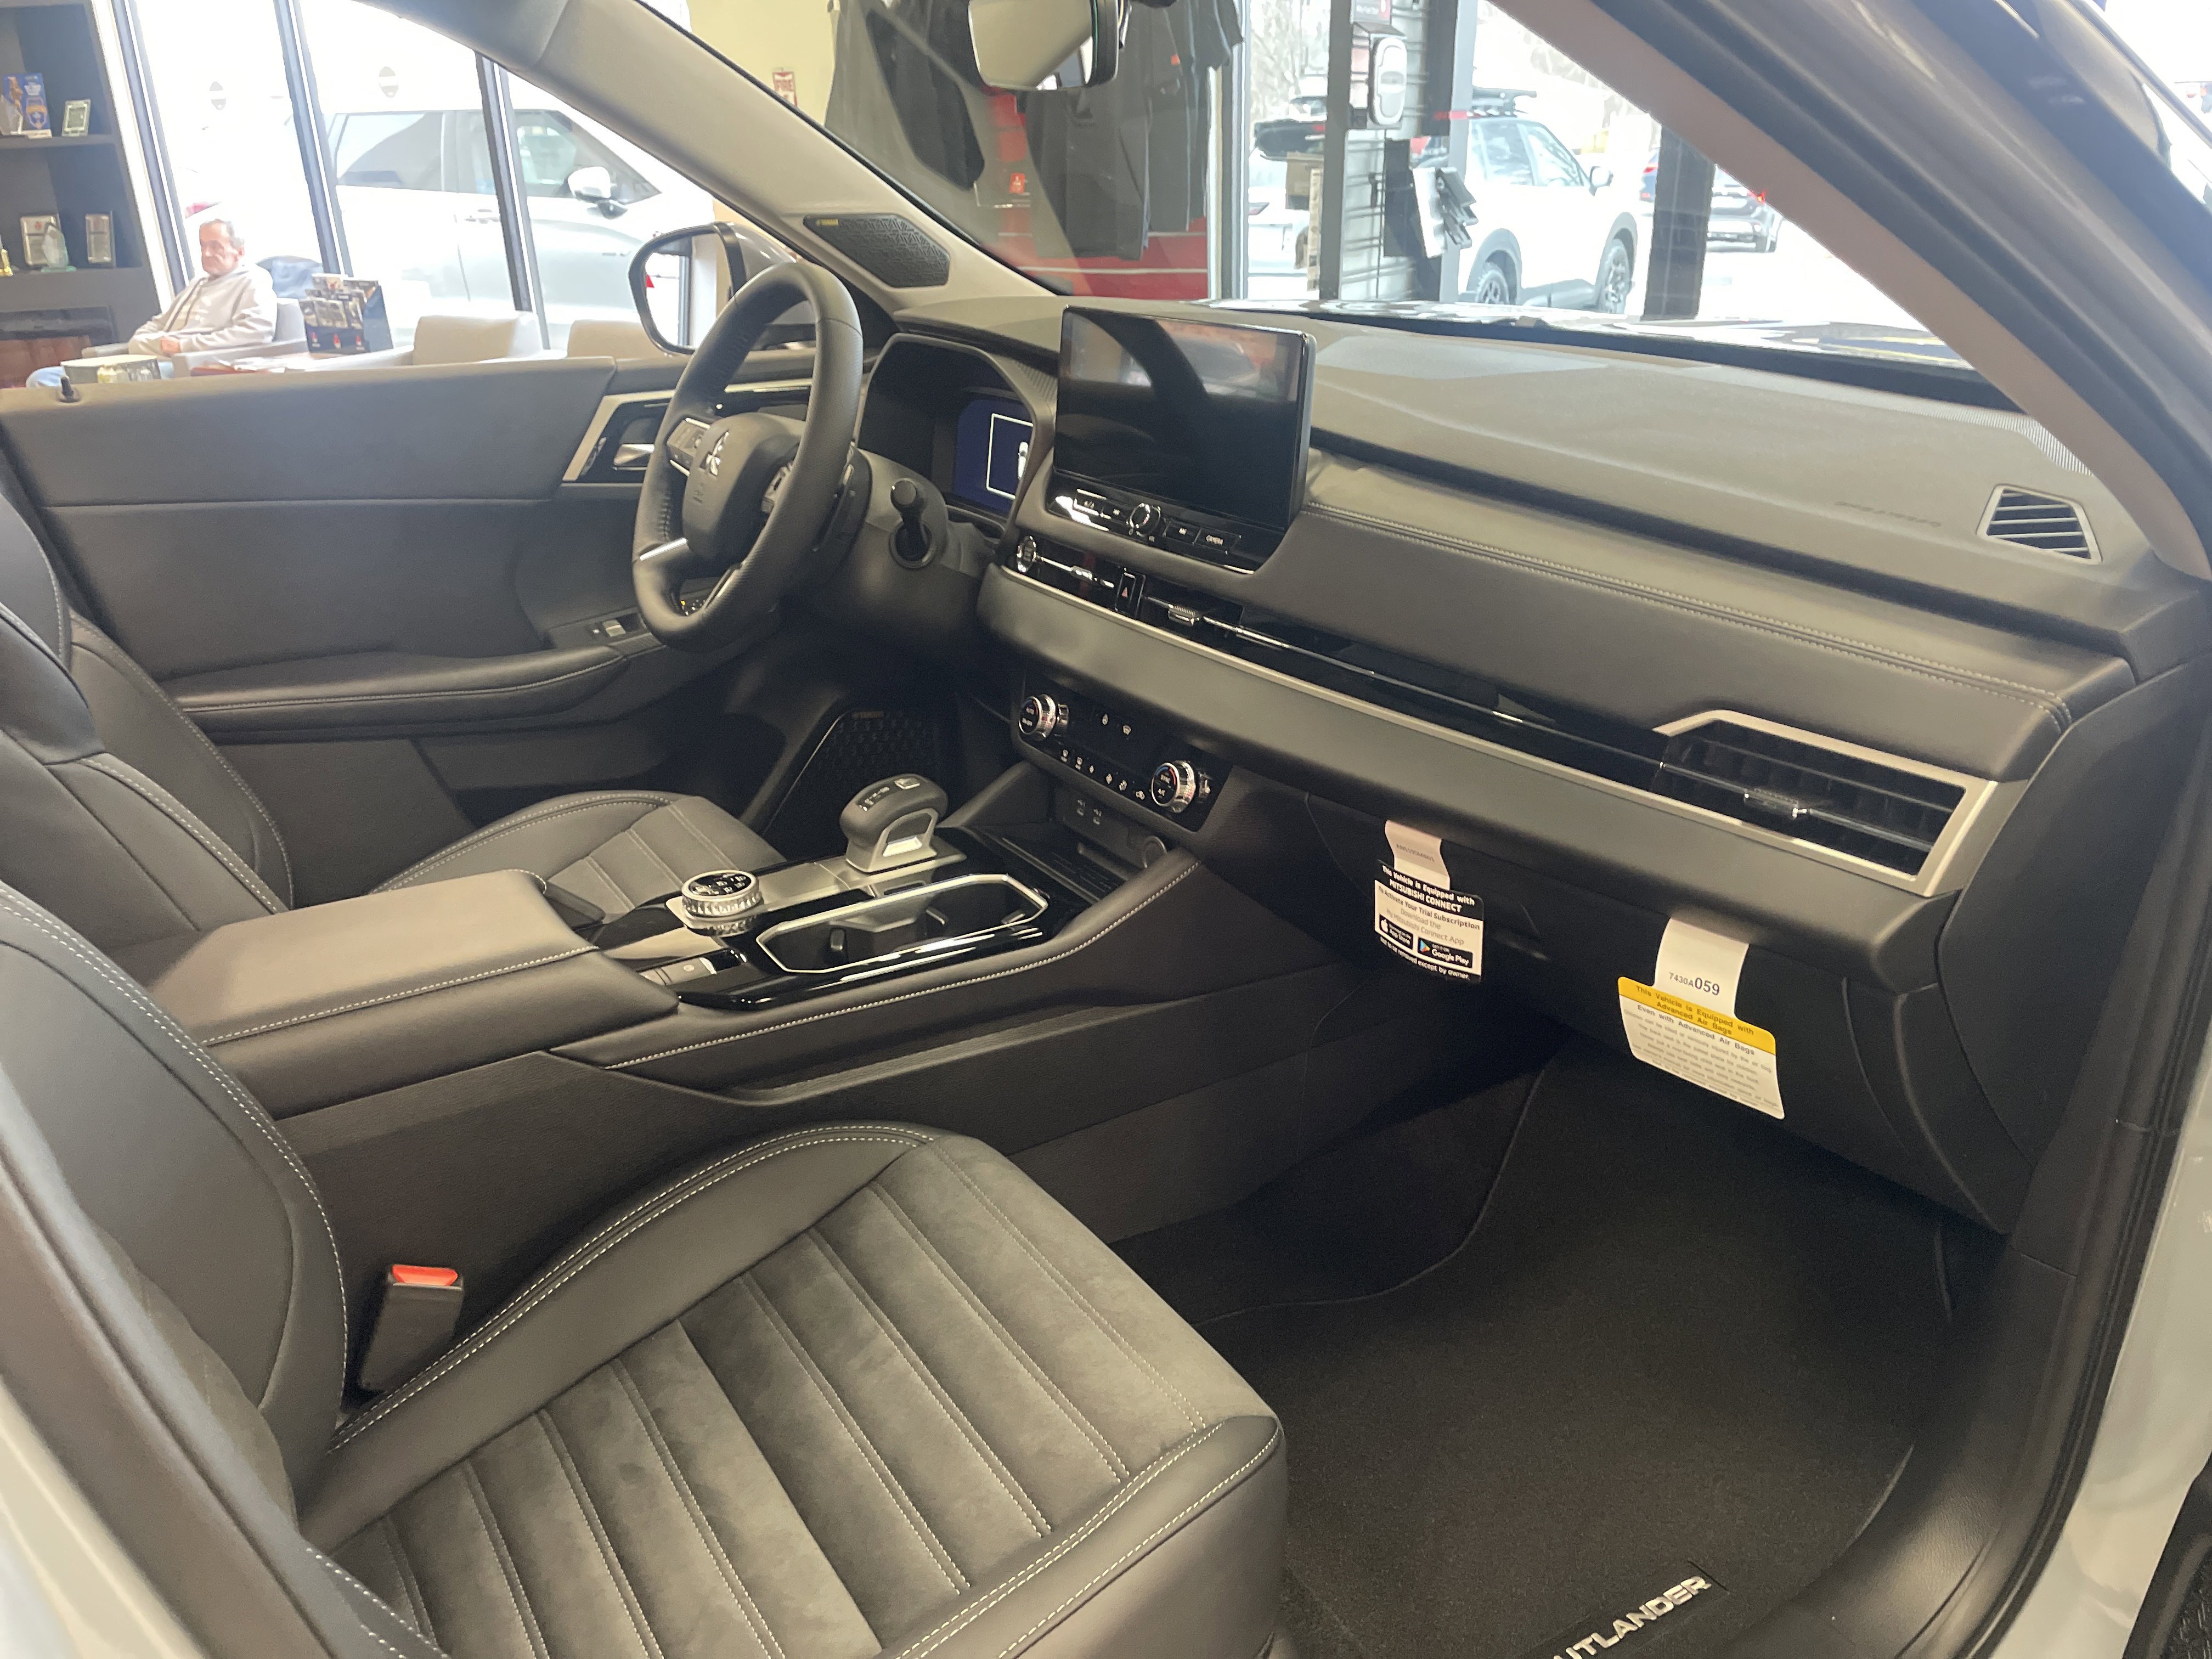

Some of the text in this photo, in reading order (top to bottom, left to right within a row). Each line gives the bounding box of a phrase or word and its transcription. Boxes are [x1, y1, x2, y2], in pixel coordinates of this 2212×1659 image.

[1382, 865, 1475, 905] This Vehicle is Equipped with
[1389, 879, 1462, 912] MITSUBISHI CONNECT
[1385, 890, 1404, 905] Activate
[1404, 900, 1417, 911] Your
[1419, 907, 1432, 917] Trial
[1434, 913, 1480, 930] Subscription
[1401, 908, 1441, 929] Download the
[1393, 913, 1419, 931] Mitsubishi
[1421, 927, 1447, 941] Connect
[1449, 936, 1464, 945] App
[1418, 960, 1437, 972] except
[1438, 966, 1447, 974] by
[1448, 969, 1470, 980] owner.
[1431, 949, 1469, 966] Google Play
[1636, 985, 1651, 996] This
[1656, 992, 1682, 1008] Vehicle
[1697, 1008, 1733, 1028] Equipped
[1737, 1024, 1754, 1035] with
[1657, 1001, 1732, 1035] Advanced Air Bags
[1638, 1005, 1754, 1056] Even with Advanced Air Bags
